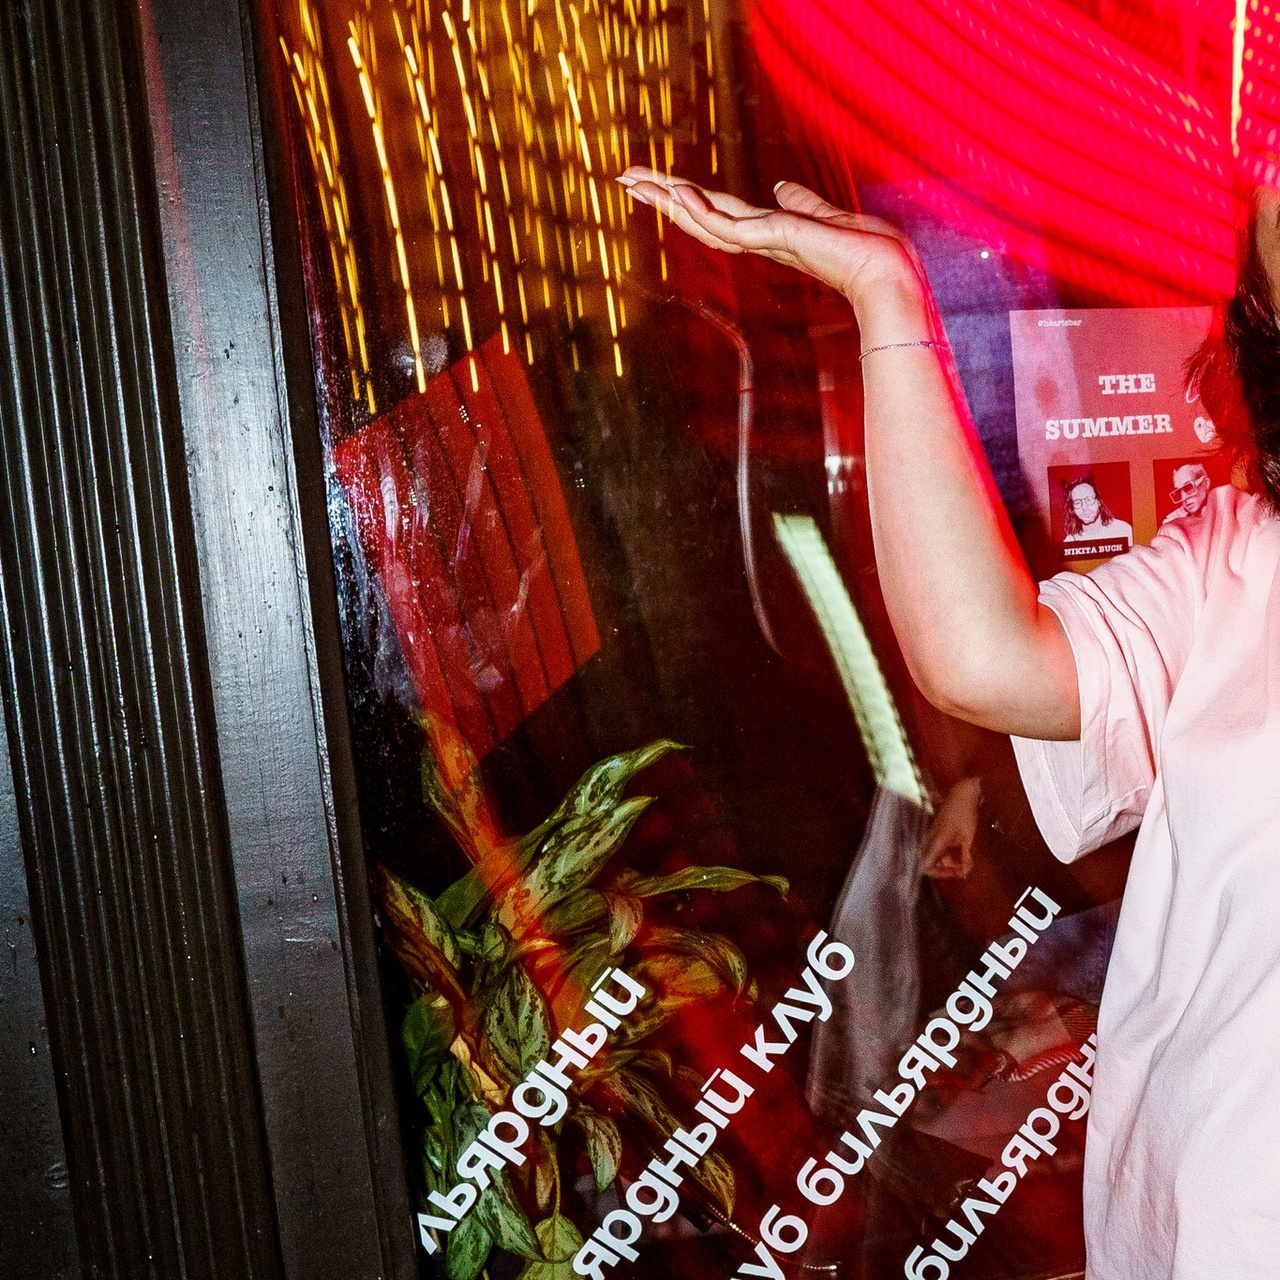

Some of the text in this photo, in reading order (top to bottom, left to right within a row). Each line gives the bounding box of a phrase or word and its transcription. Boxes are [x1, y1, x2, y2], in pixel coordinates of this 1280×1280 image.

[1099, 373, 1156, 396] THE
[1045, 414, 1173, 440] SUMMER
[1064, 544, 1123, 556] NIKITA BUCH
[739, 930, 857, 1073] клуб
[796, 886, 1062, 1207] бильярдный
[417, 966, 647, 1255] льярдный
